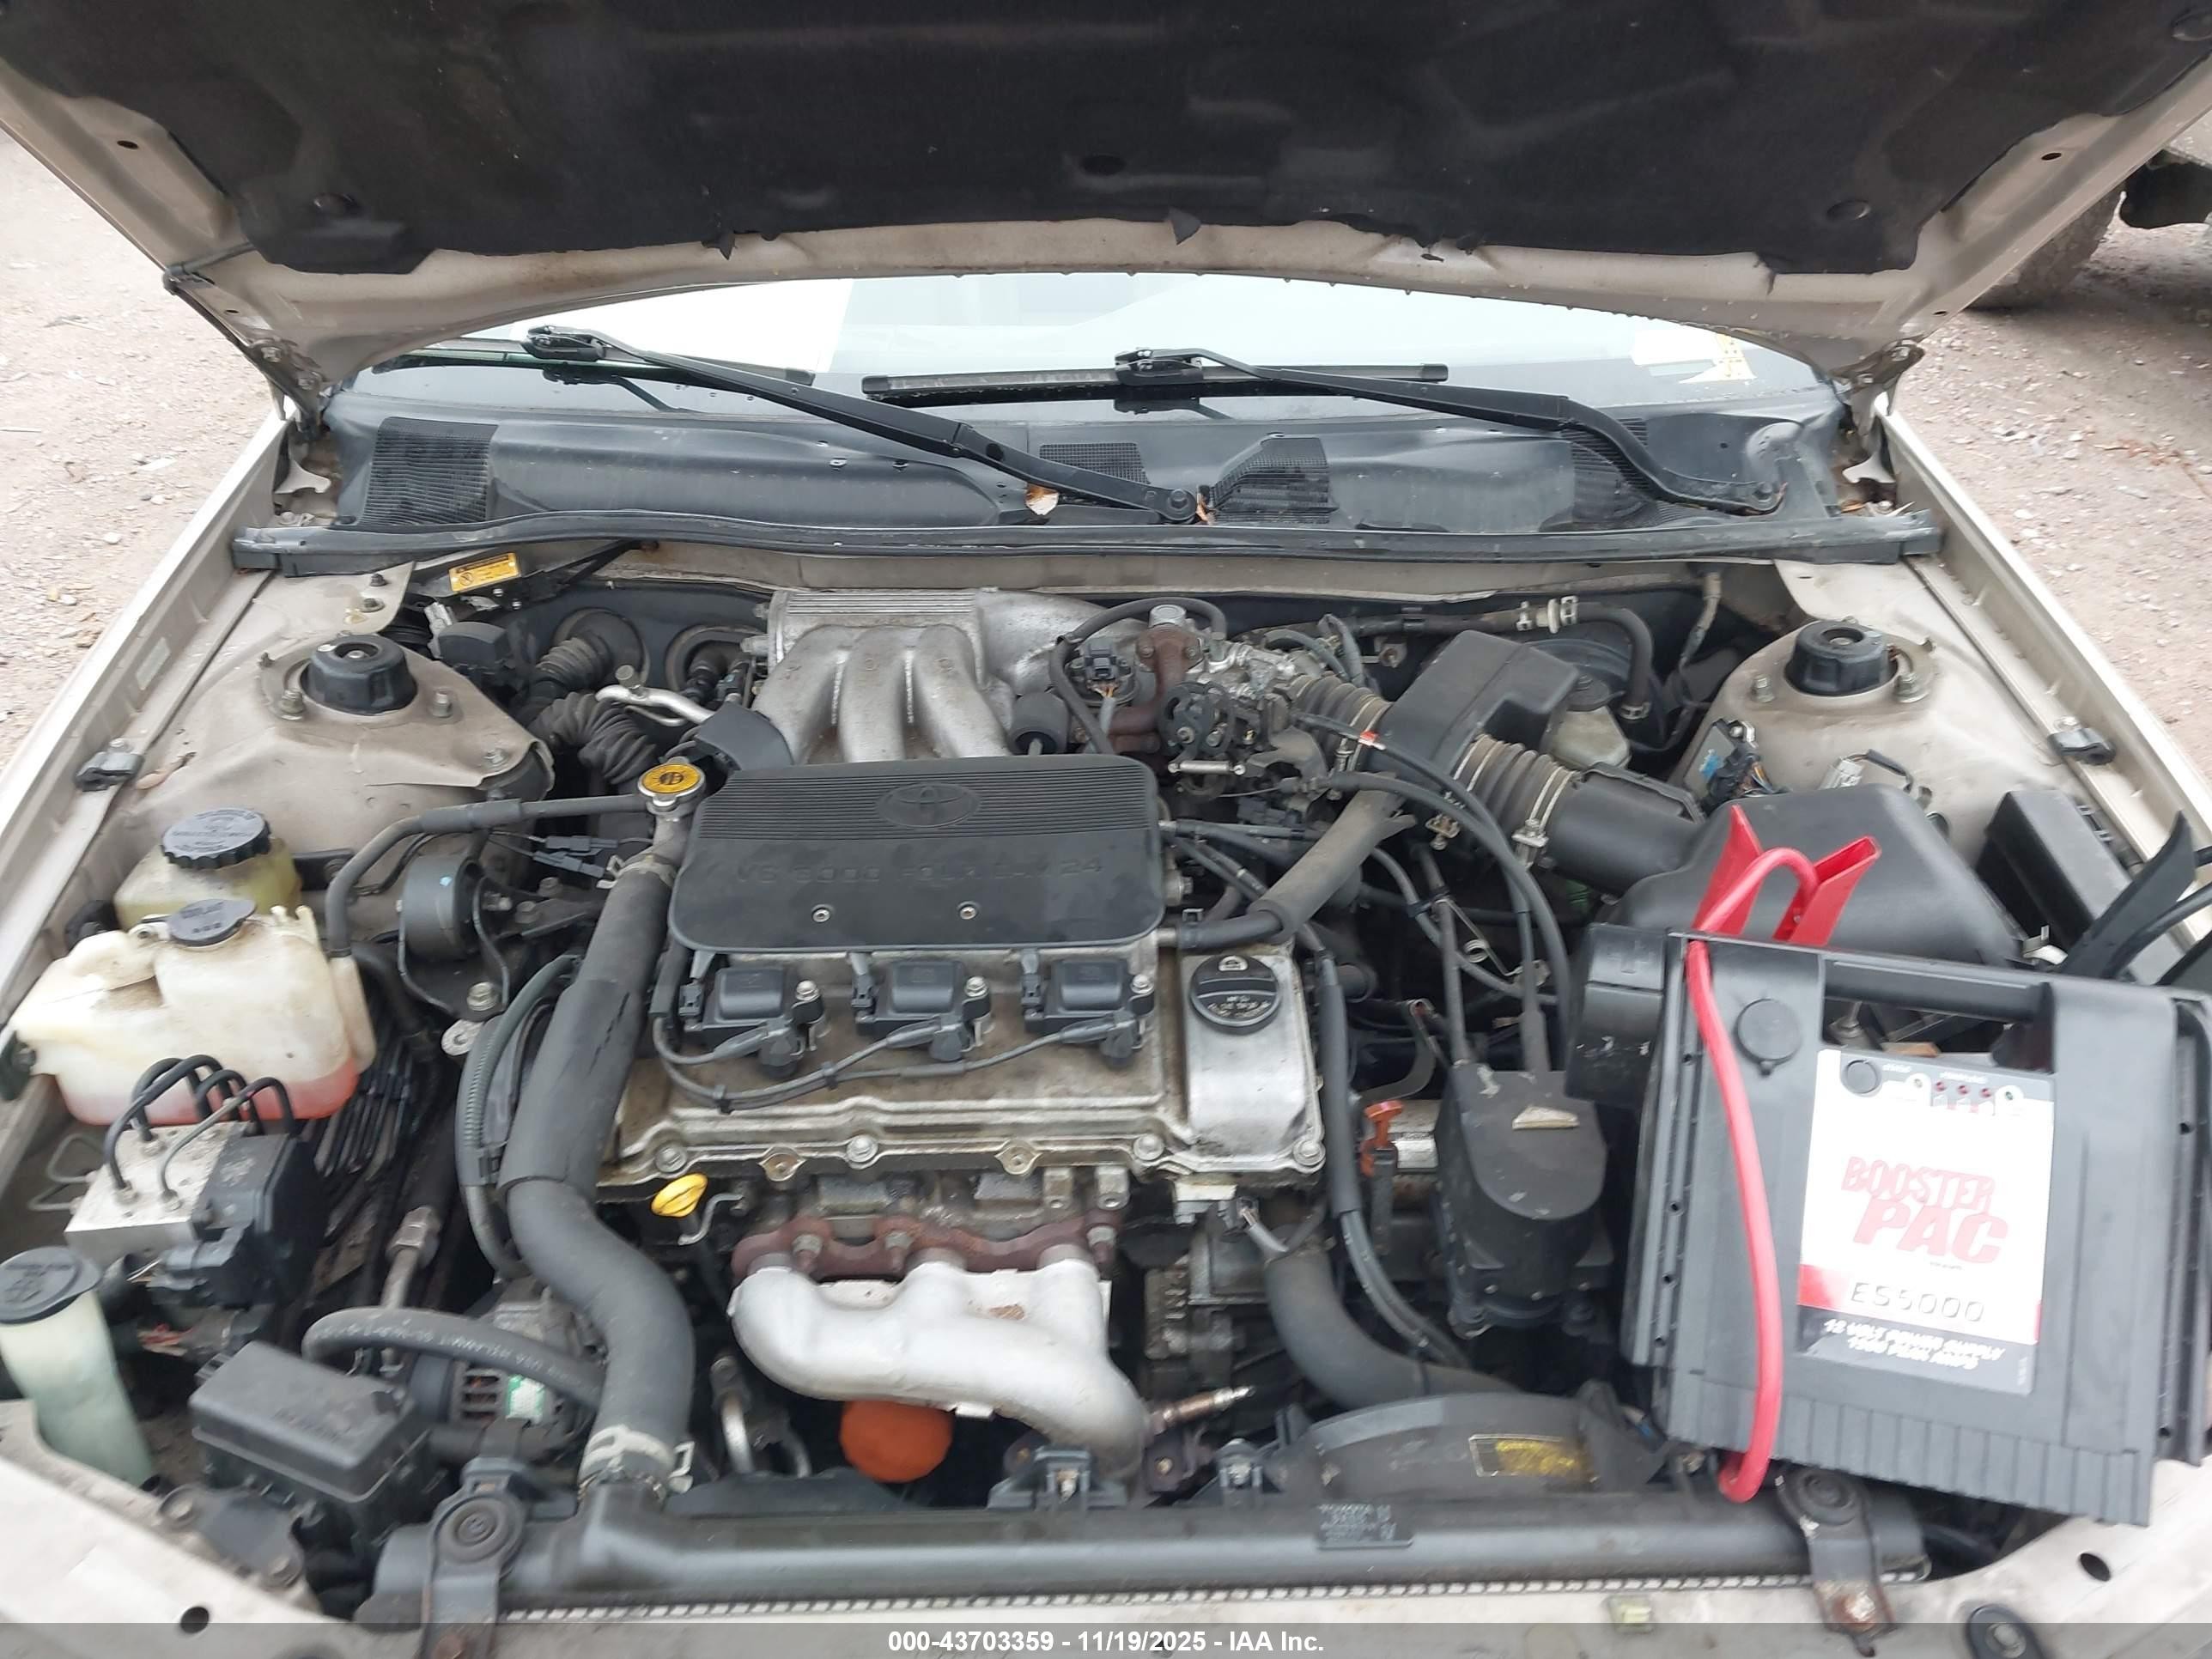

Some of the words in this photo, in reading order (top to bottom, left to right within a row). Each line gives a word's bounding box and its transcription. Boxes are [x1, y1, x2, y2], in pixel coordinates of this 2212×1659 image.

[1840, 1156, 1996, 1212] BOOSTER
[1853, 1196, 2008, 1264] PAC
[1850, 1282, 1984, 1322] ES5000
